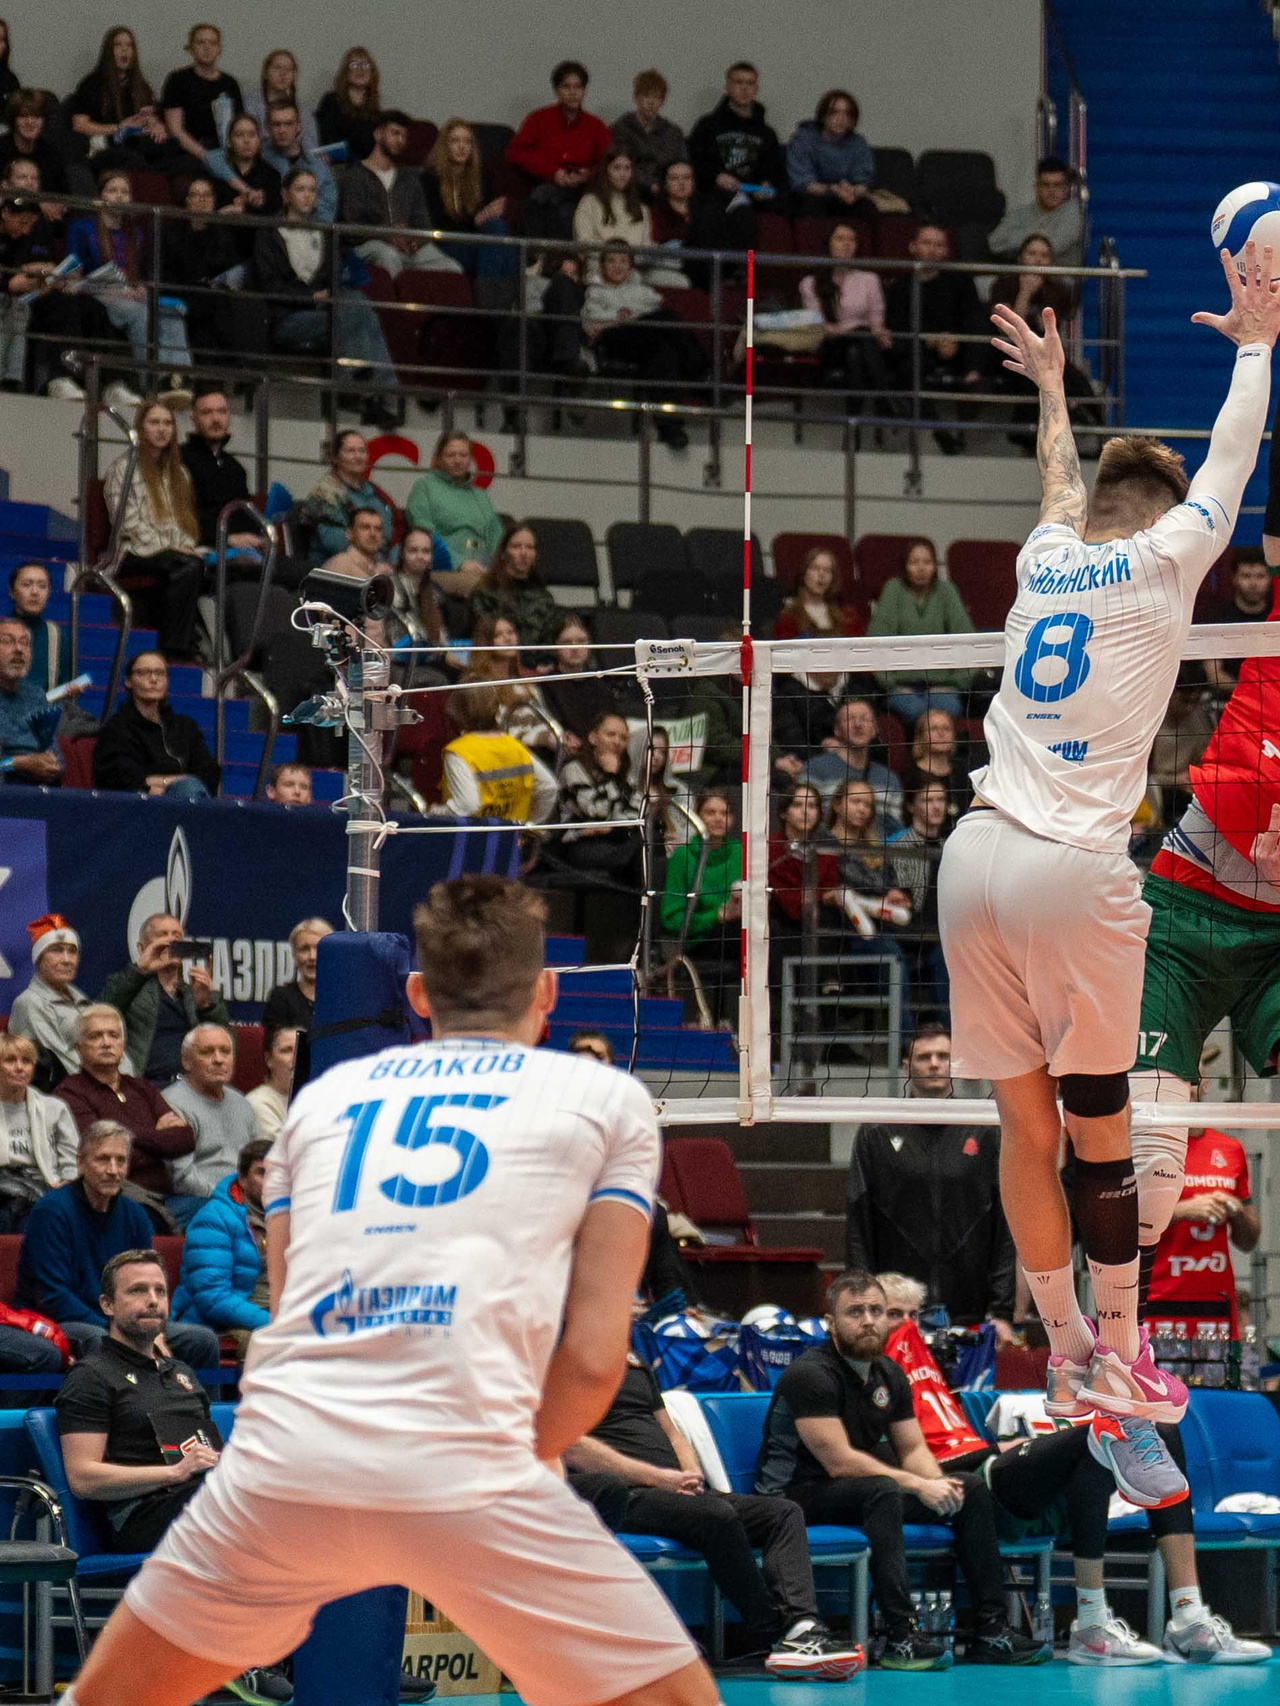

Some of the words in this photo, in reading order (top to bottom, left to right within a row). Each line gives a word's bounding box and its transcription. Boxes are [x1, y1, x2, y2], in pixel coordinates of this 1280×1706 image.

[656, 645, 685, 654] Senoh
[1014, 612, 1094, 703] 8
[1138, 1031, 1168, 1057] 17
[368, 1053, 526, 1080] ВОЛКОВ
[332, 1093, 509, 1214] 15
[358, 1285, 457, 1312] ГАЗПРОМ
